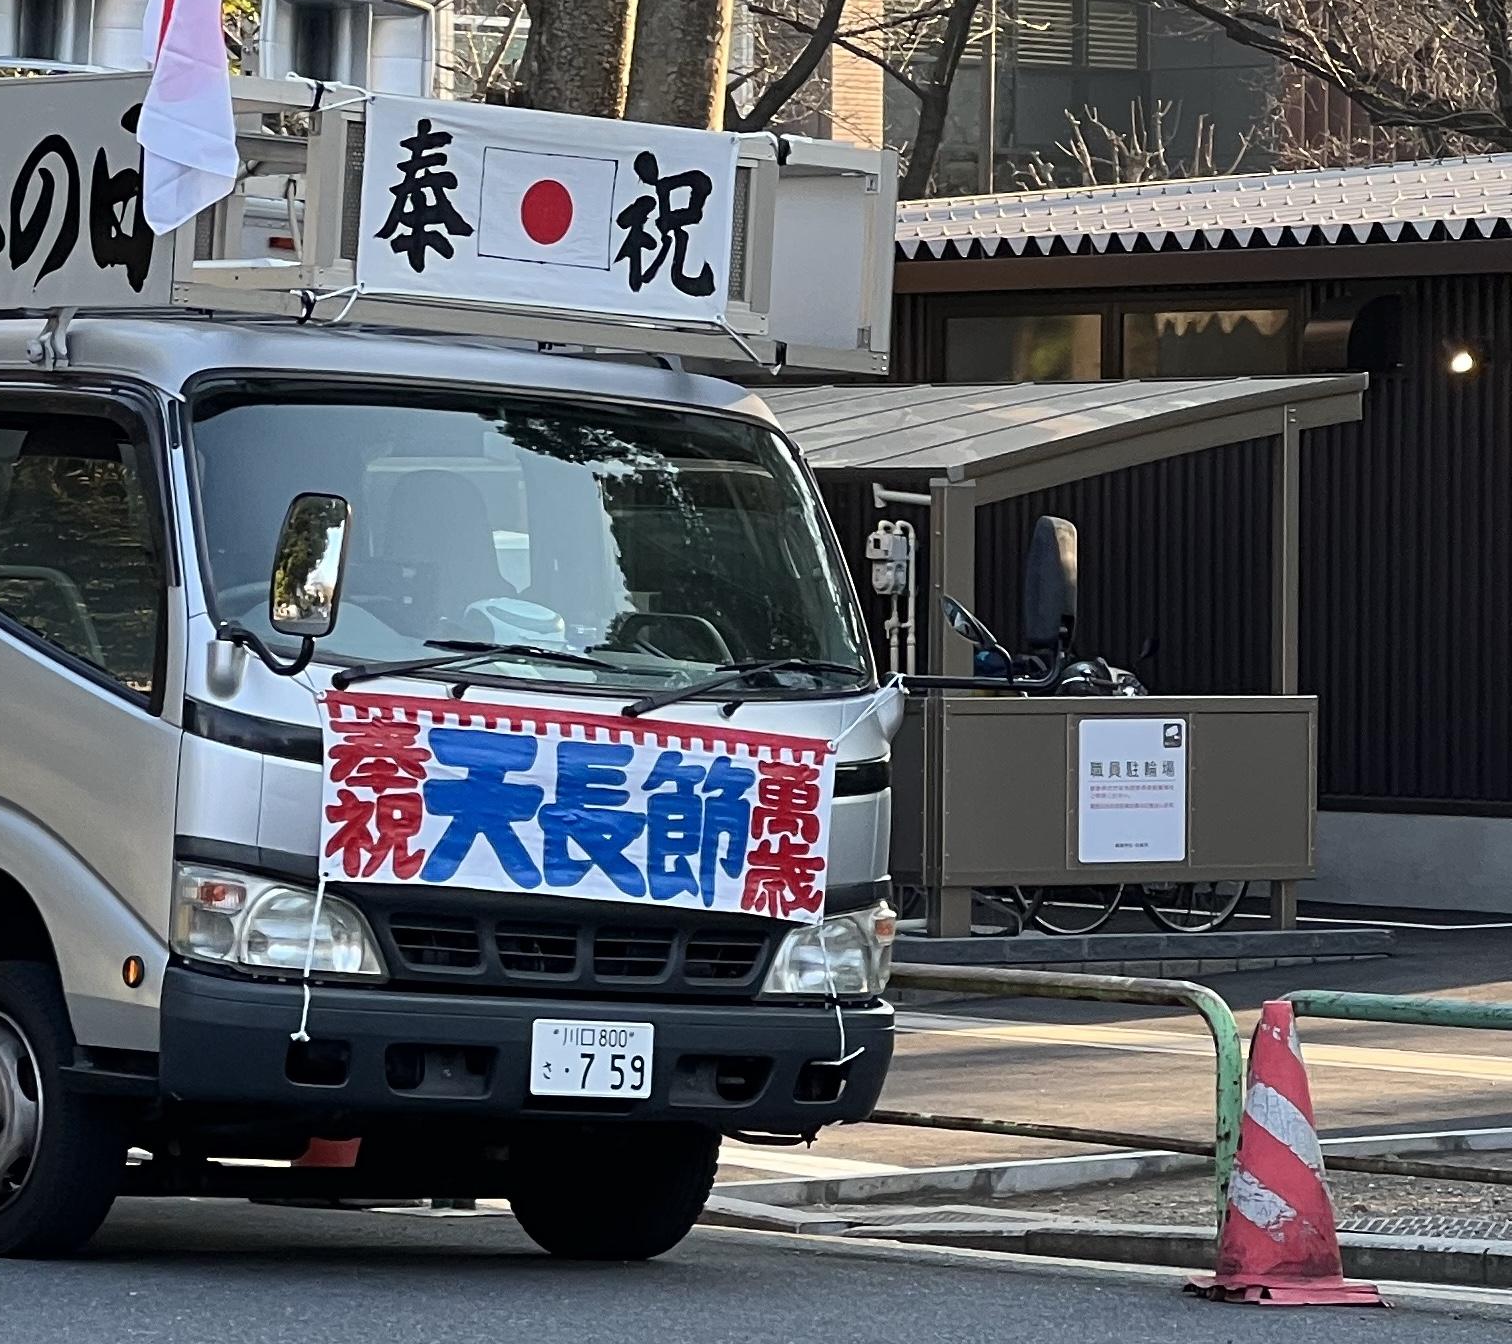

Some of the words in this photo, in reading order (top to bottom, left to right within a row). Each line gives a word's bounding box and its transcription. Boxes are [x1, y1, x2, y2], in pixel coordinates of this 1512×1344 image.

[374, 119, 475, 274] 奉
[612, 151, 716, 297] 祝
[325, 718, 432, 880] 奉祝
[419, 728, 757, 908] 天長節
[598, 1029, 628, 1047] 800
